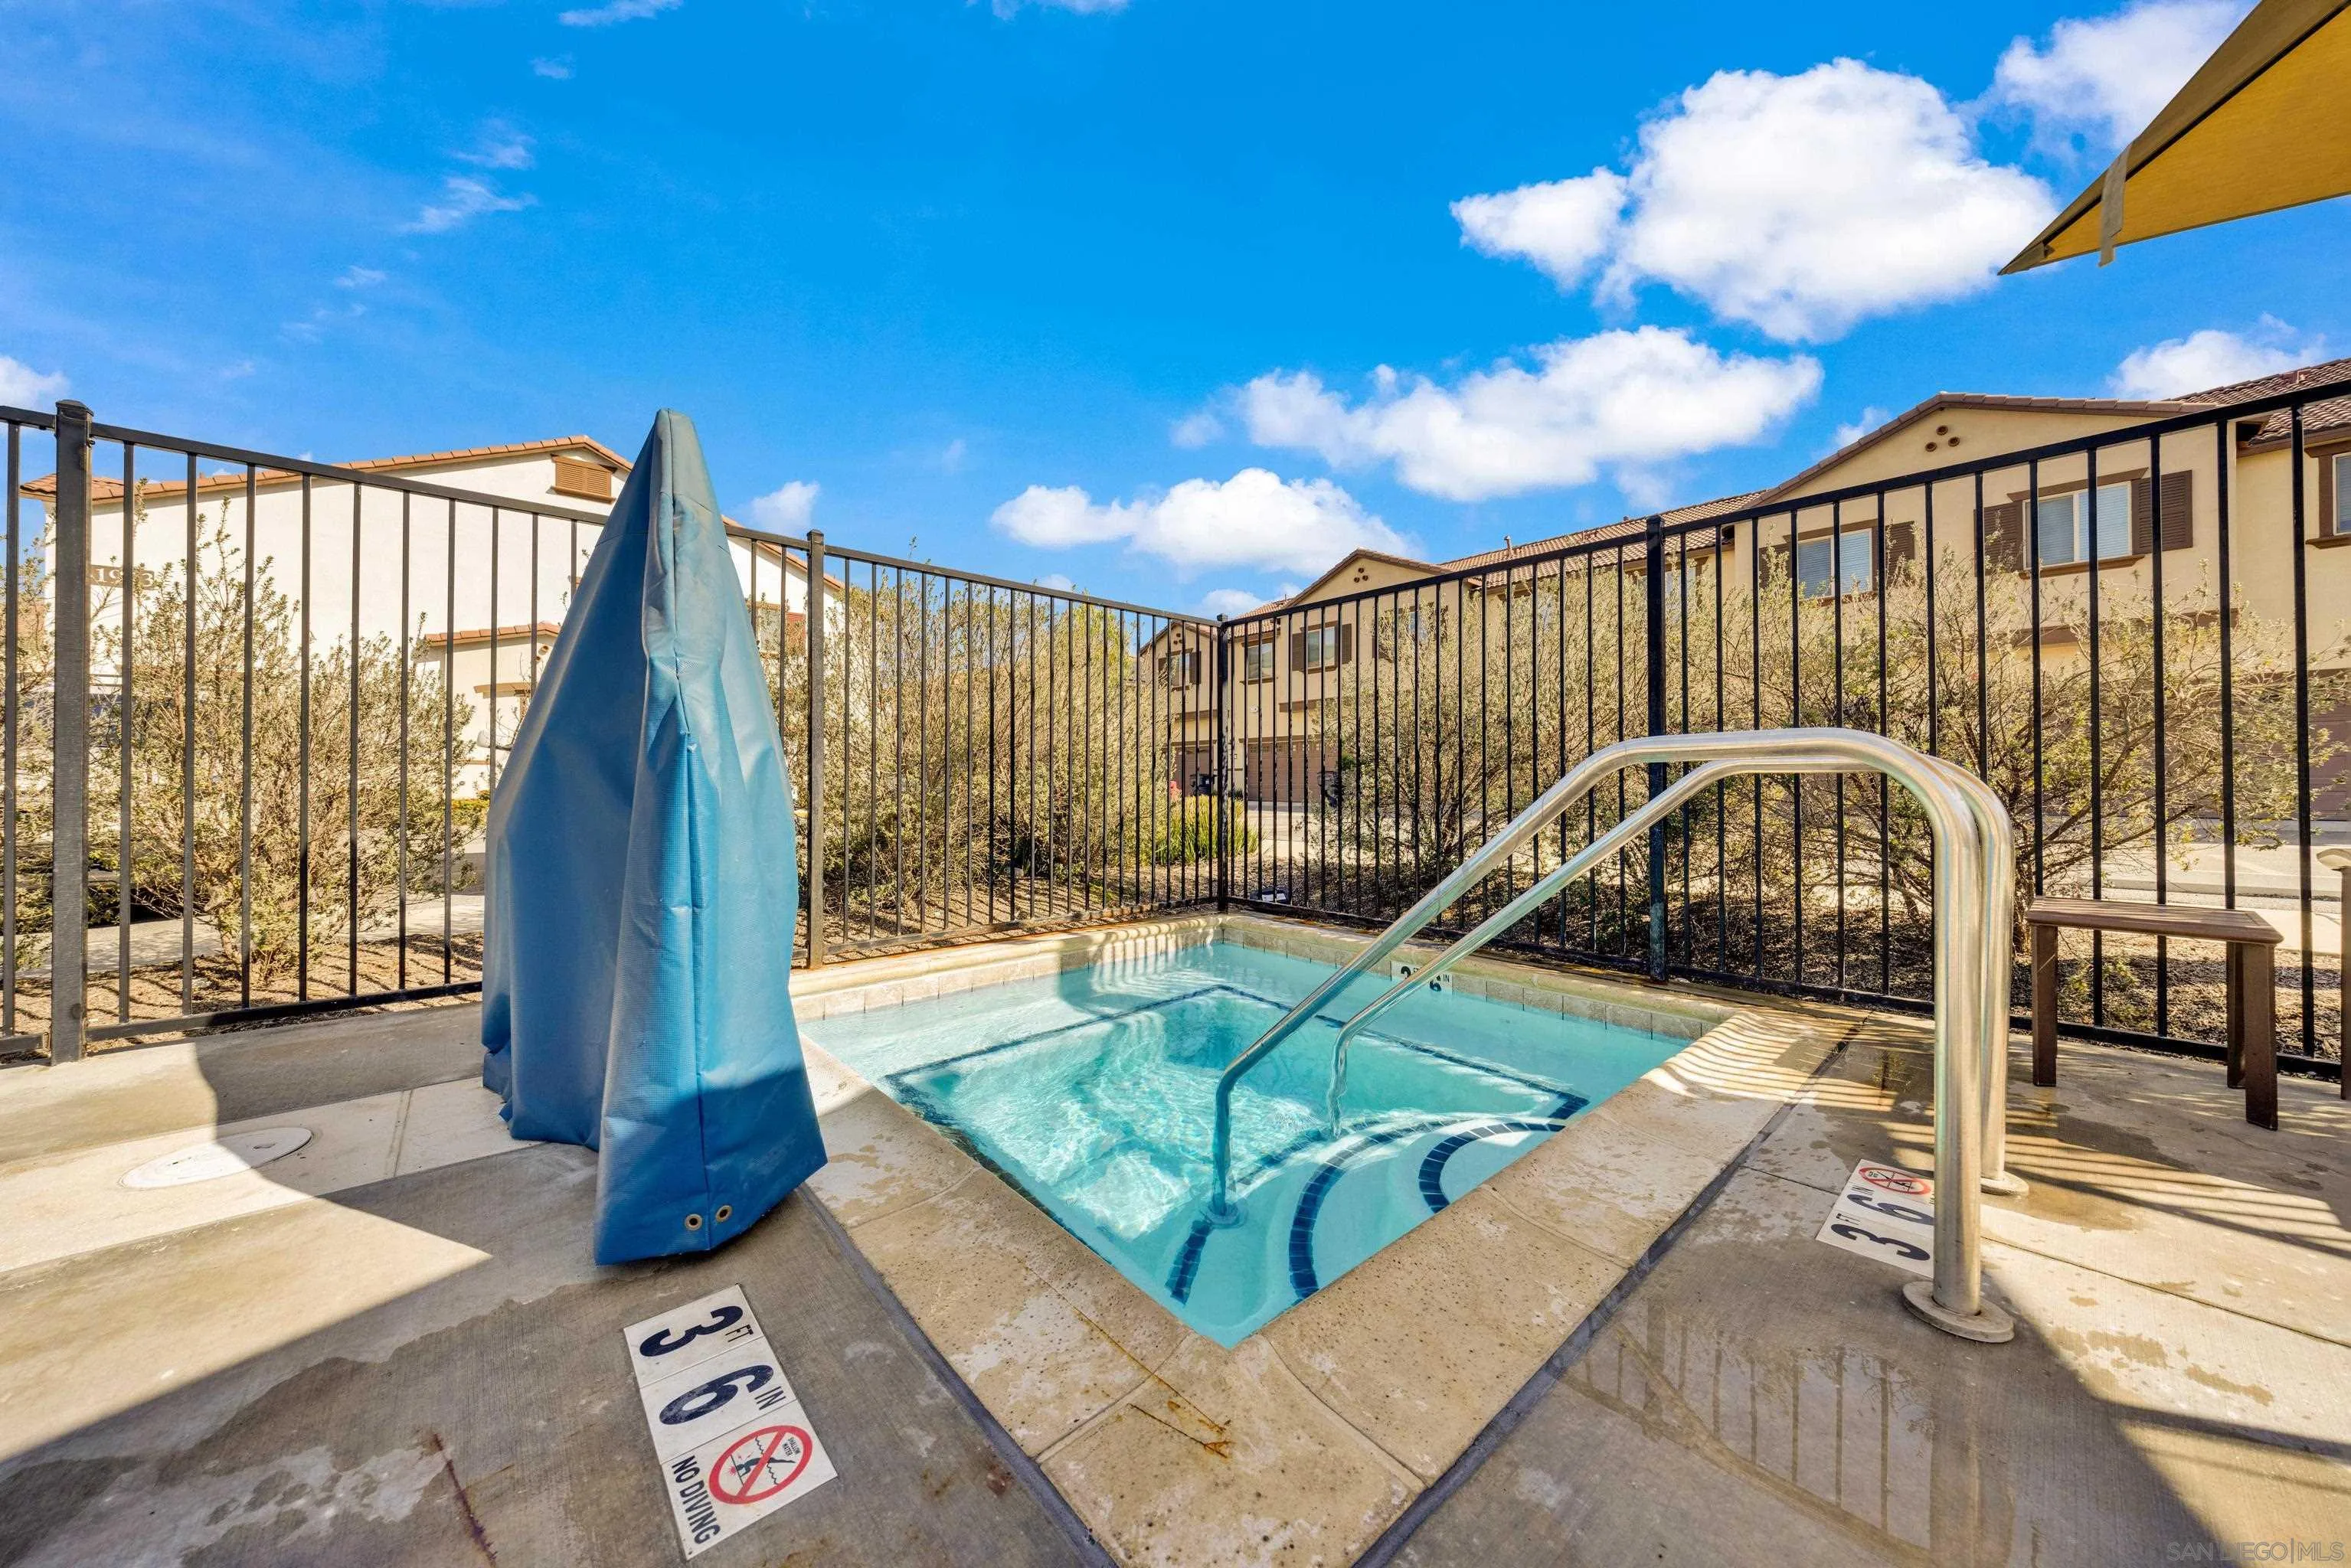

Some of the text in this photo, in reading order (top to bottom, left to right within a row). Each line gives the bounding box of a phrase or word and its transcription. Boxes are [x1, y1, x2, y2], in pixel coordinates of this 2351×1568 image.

[1443, 973, 1450, 983] IN
[1836, 1213, 1860, 1225] FT
[1846, 1194, 1934, 1225] 6
[1831, 1223, 1931, 1261] 3
[639, 1305, 786, 1425] 3 FT 6 IN
[672, 1455, 721, 1544] NO DIVING
